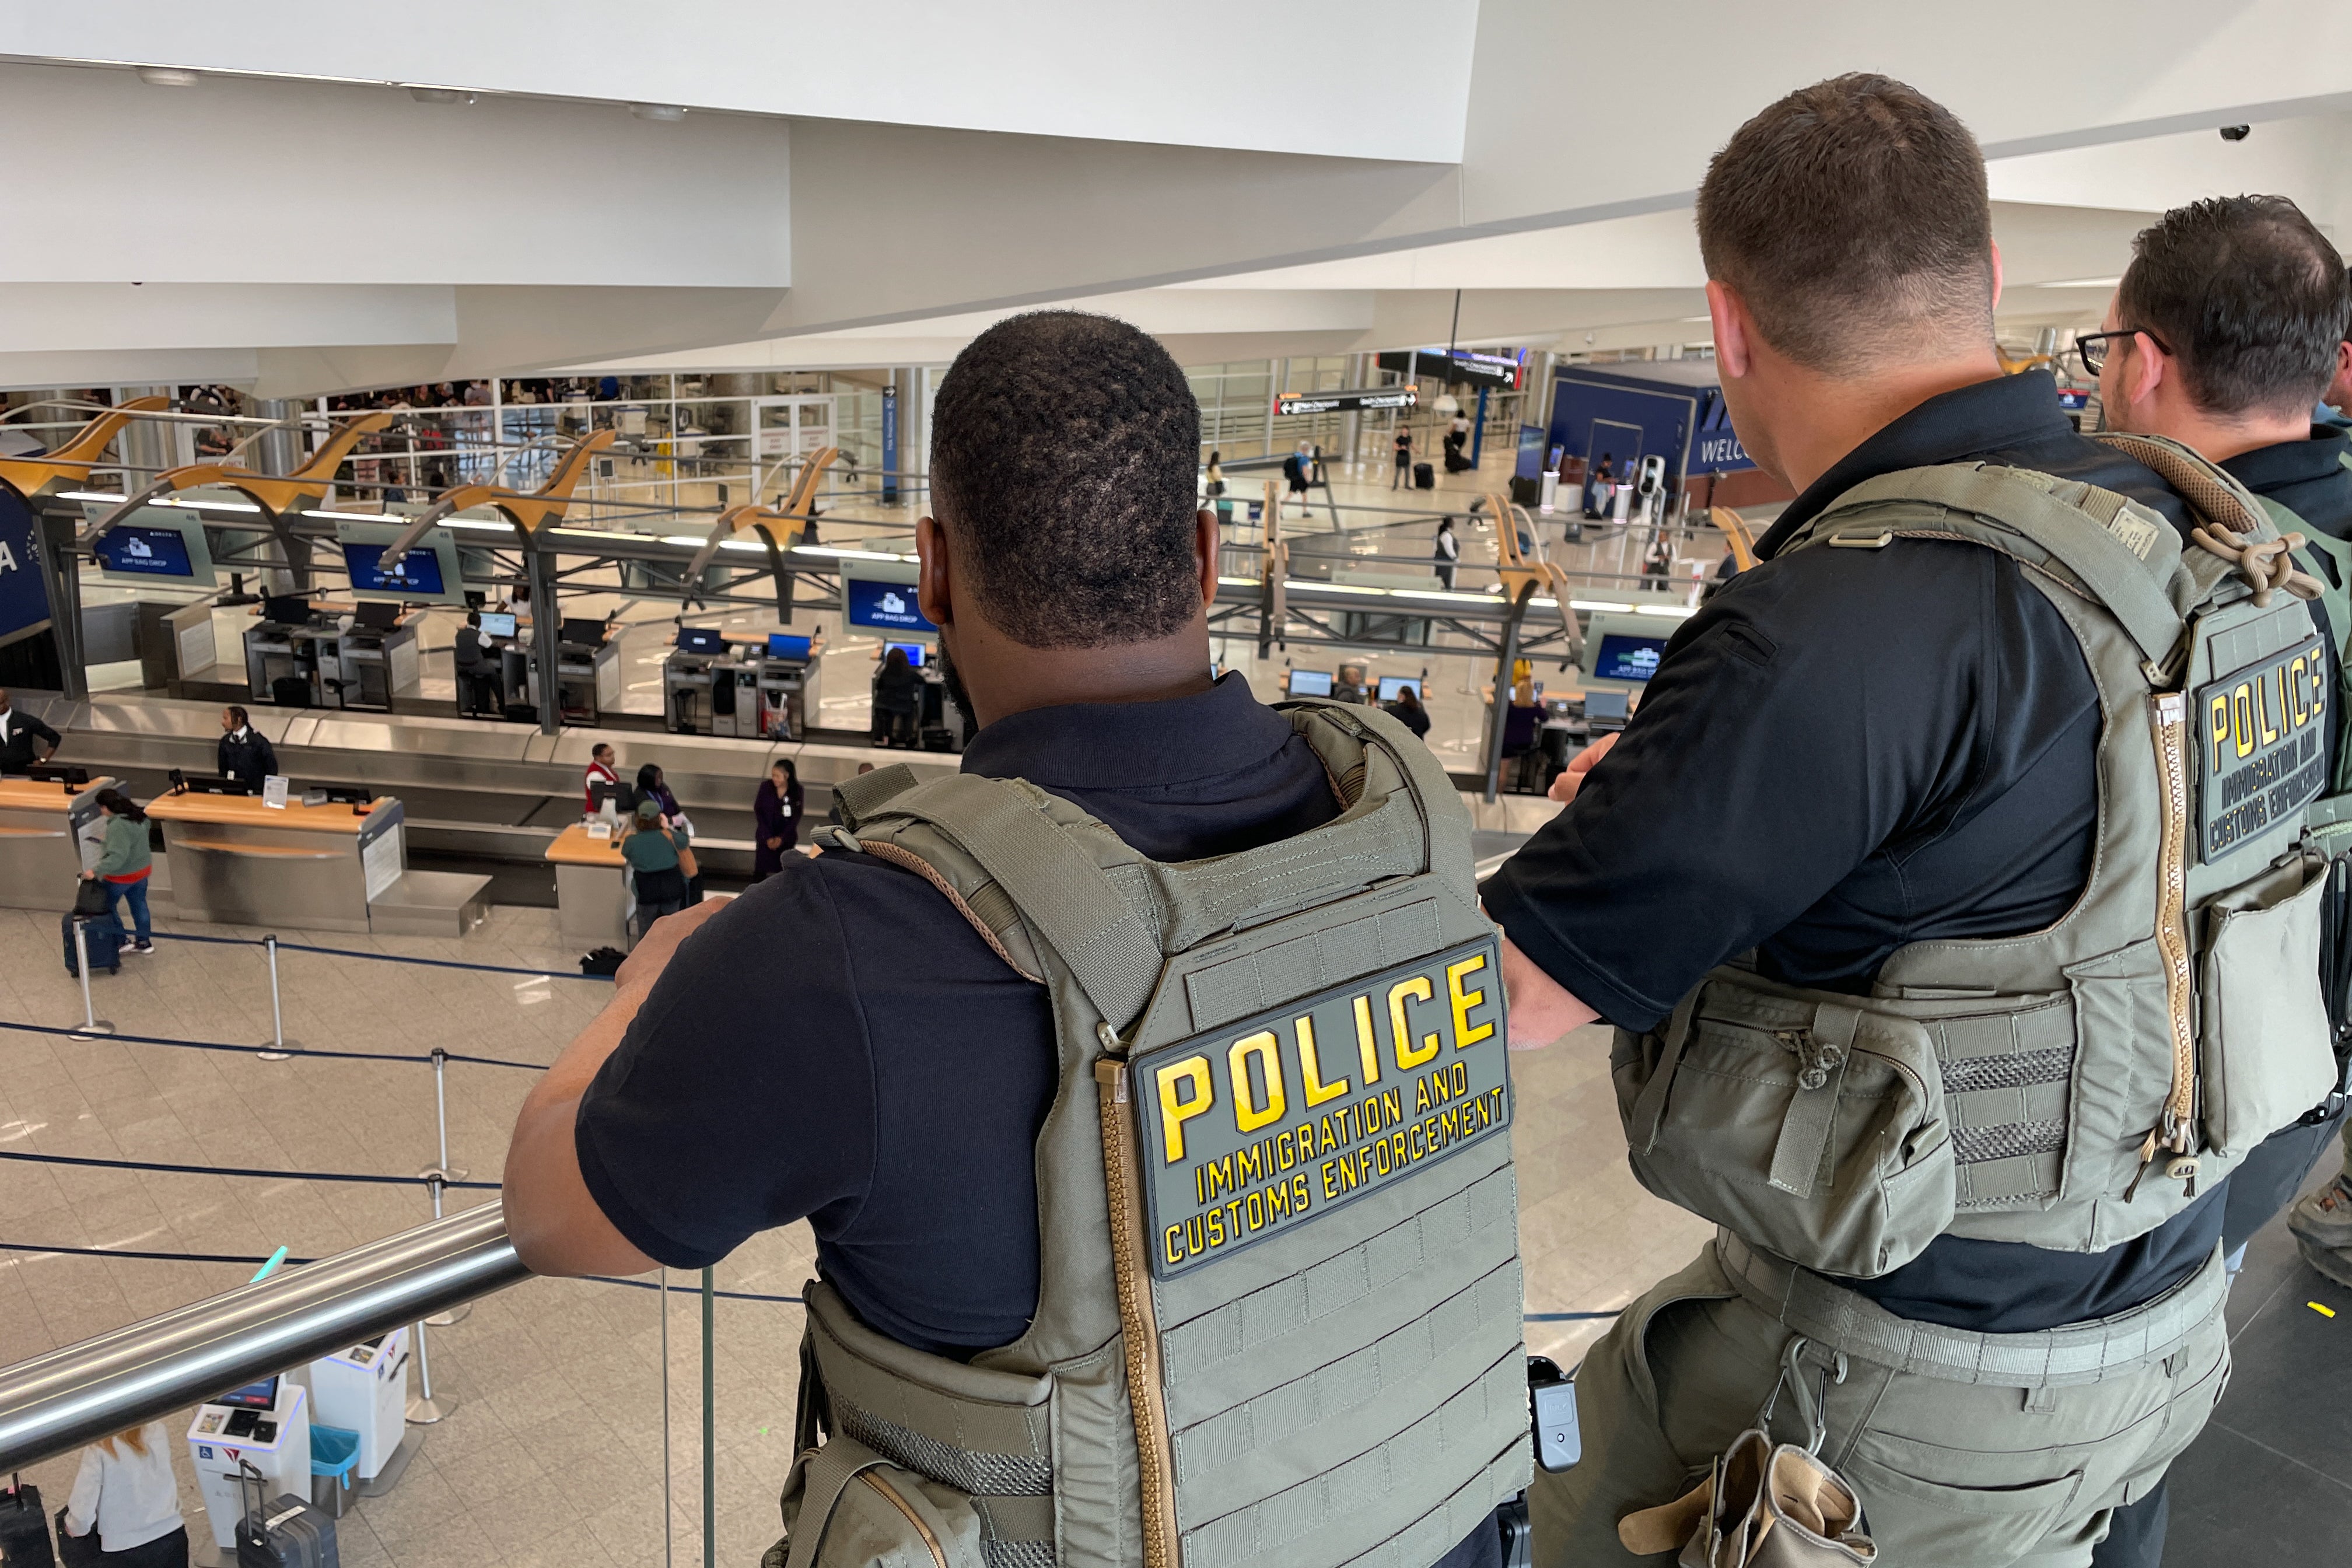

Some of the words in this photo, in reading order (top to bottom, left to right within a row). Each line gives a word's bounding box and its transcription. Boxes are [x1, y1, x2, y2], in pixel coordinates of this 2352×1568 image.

[1702, 438, 1749, 464] WELC
[2211, 647, 2324, 774] POLICE
[2222, 738, 2298, 811] IMMIGRATION
[2300, 726, 2316, 766] AND
[2210, 796, 2267, 853] CUSTOMS
[1155, 953, 1496, 1164] POLICE
[1166, 1174, 1310, 1265] CUSTOMS
[1322, 1087, 1504, 1200] ENFORCEMENT
[1195, 1088, 1402, 1205] IMMIGRATION
[1416, 1062, 1467, 1113] AND
